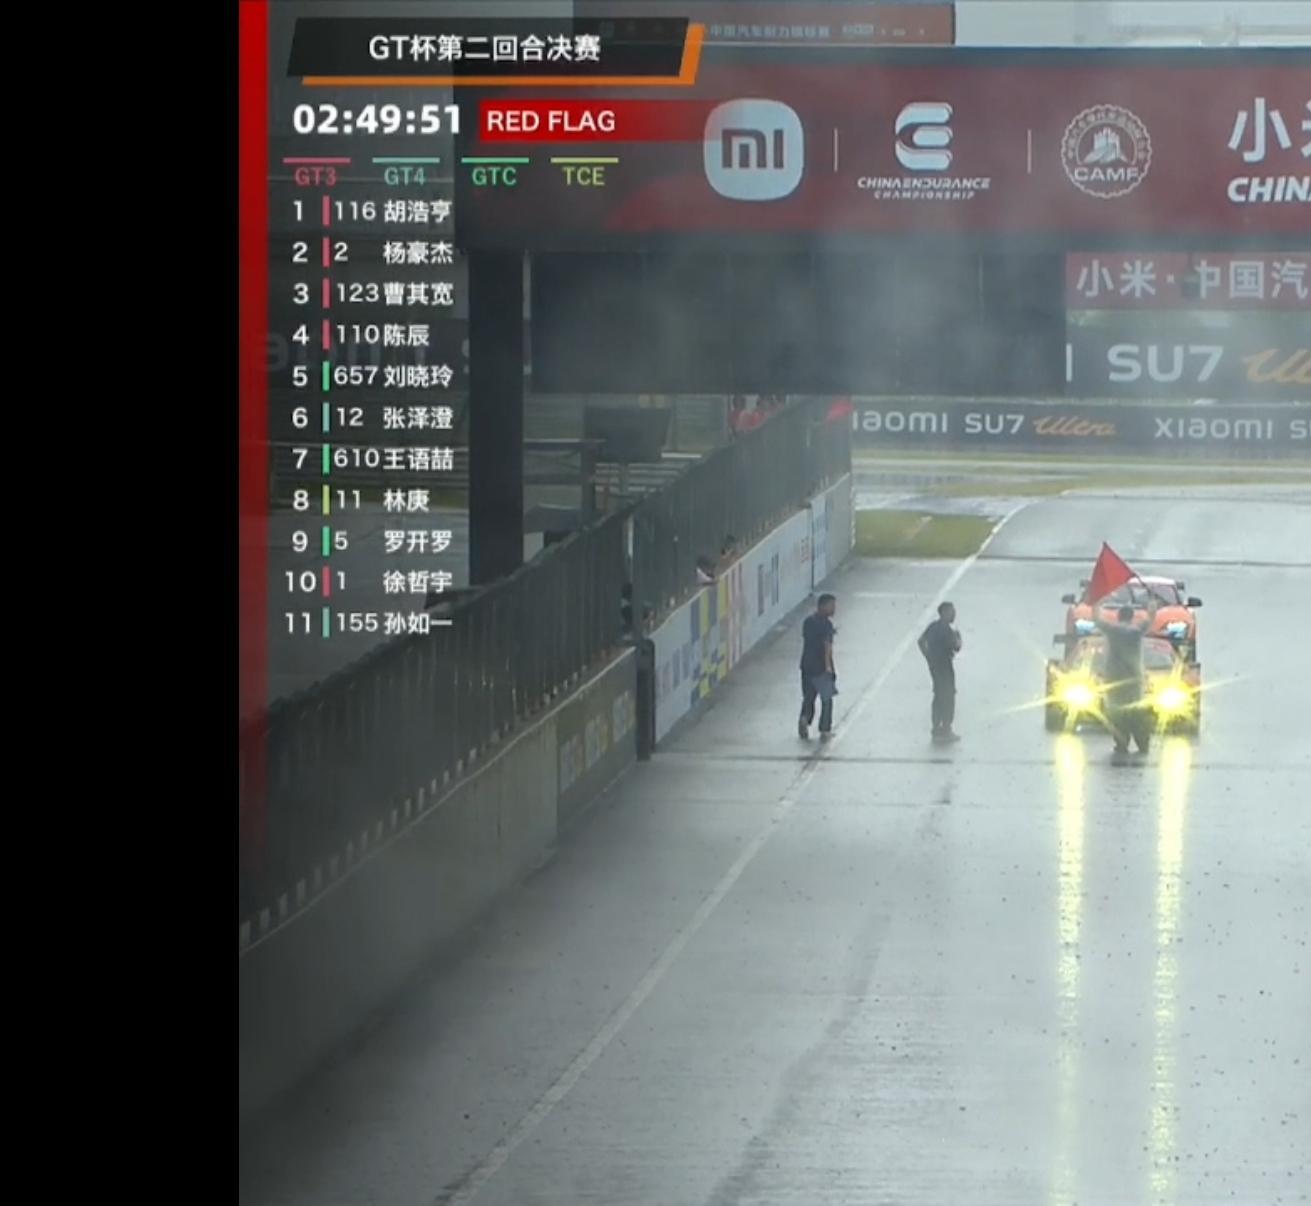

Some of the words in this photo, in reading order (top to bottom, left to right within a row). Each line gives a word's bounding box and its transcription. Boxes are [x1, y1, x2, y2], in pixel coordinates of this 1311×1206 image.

[1074, 167, 1139, 181] CAMF
[857, 177, 901, 189] CHINA
[902, 177, 991, 190] ENDURANCE
[874, 190, 975, 200] CHAMPIONSHIP
[1106, 345, 1224, 382] SU7
[964, 413, 1025, 434] SU7
[1033, 415, 1117, 436] Ultra
